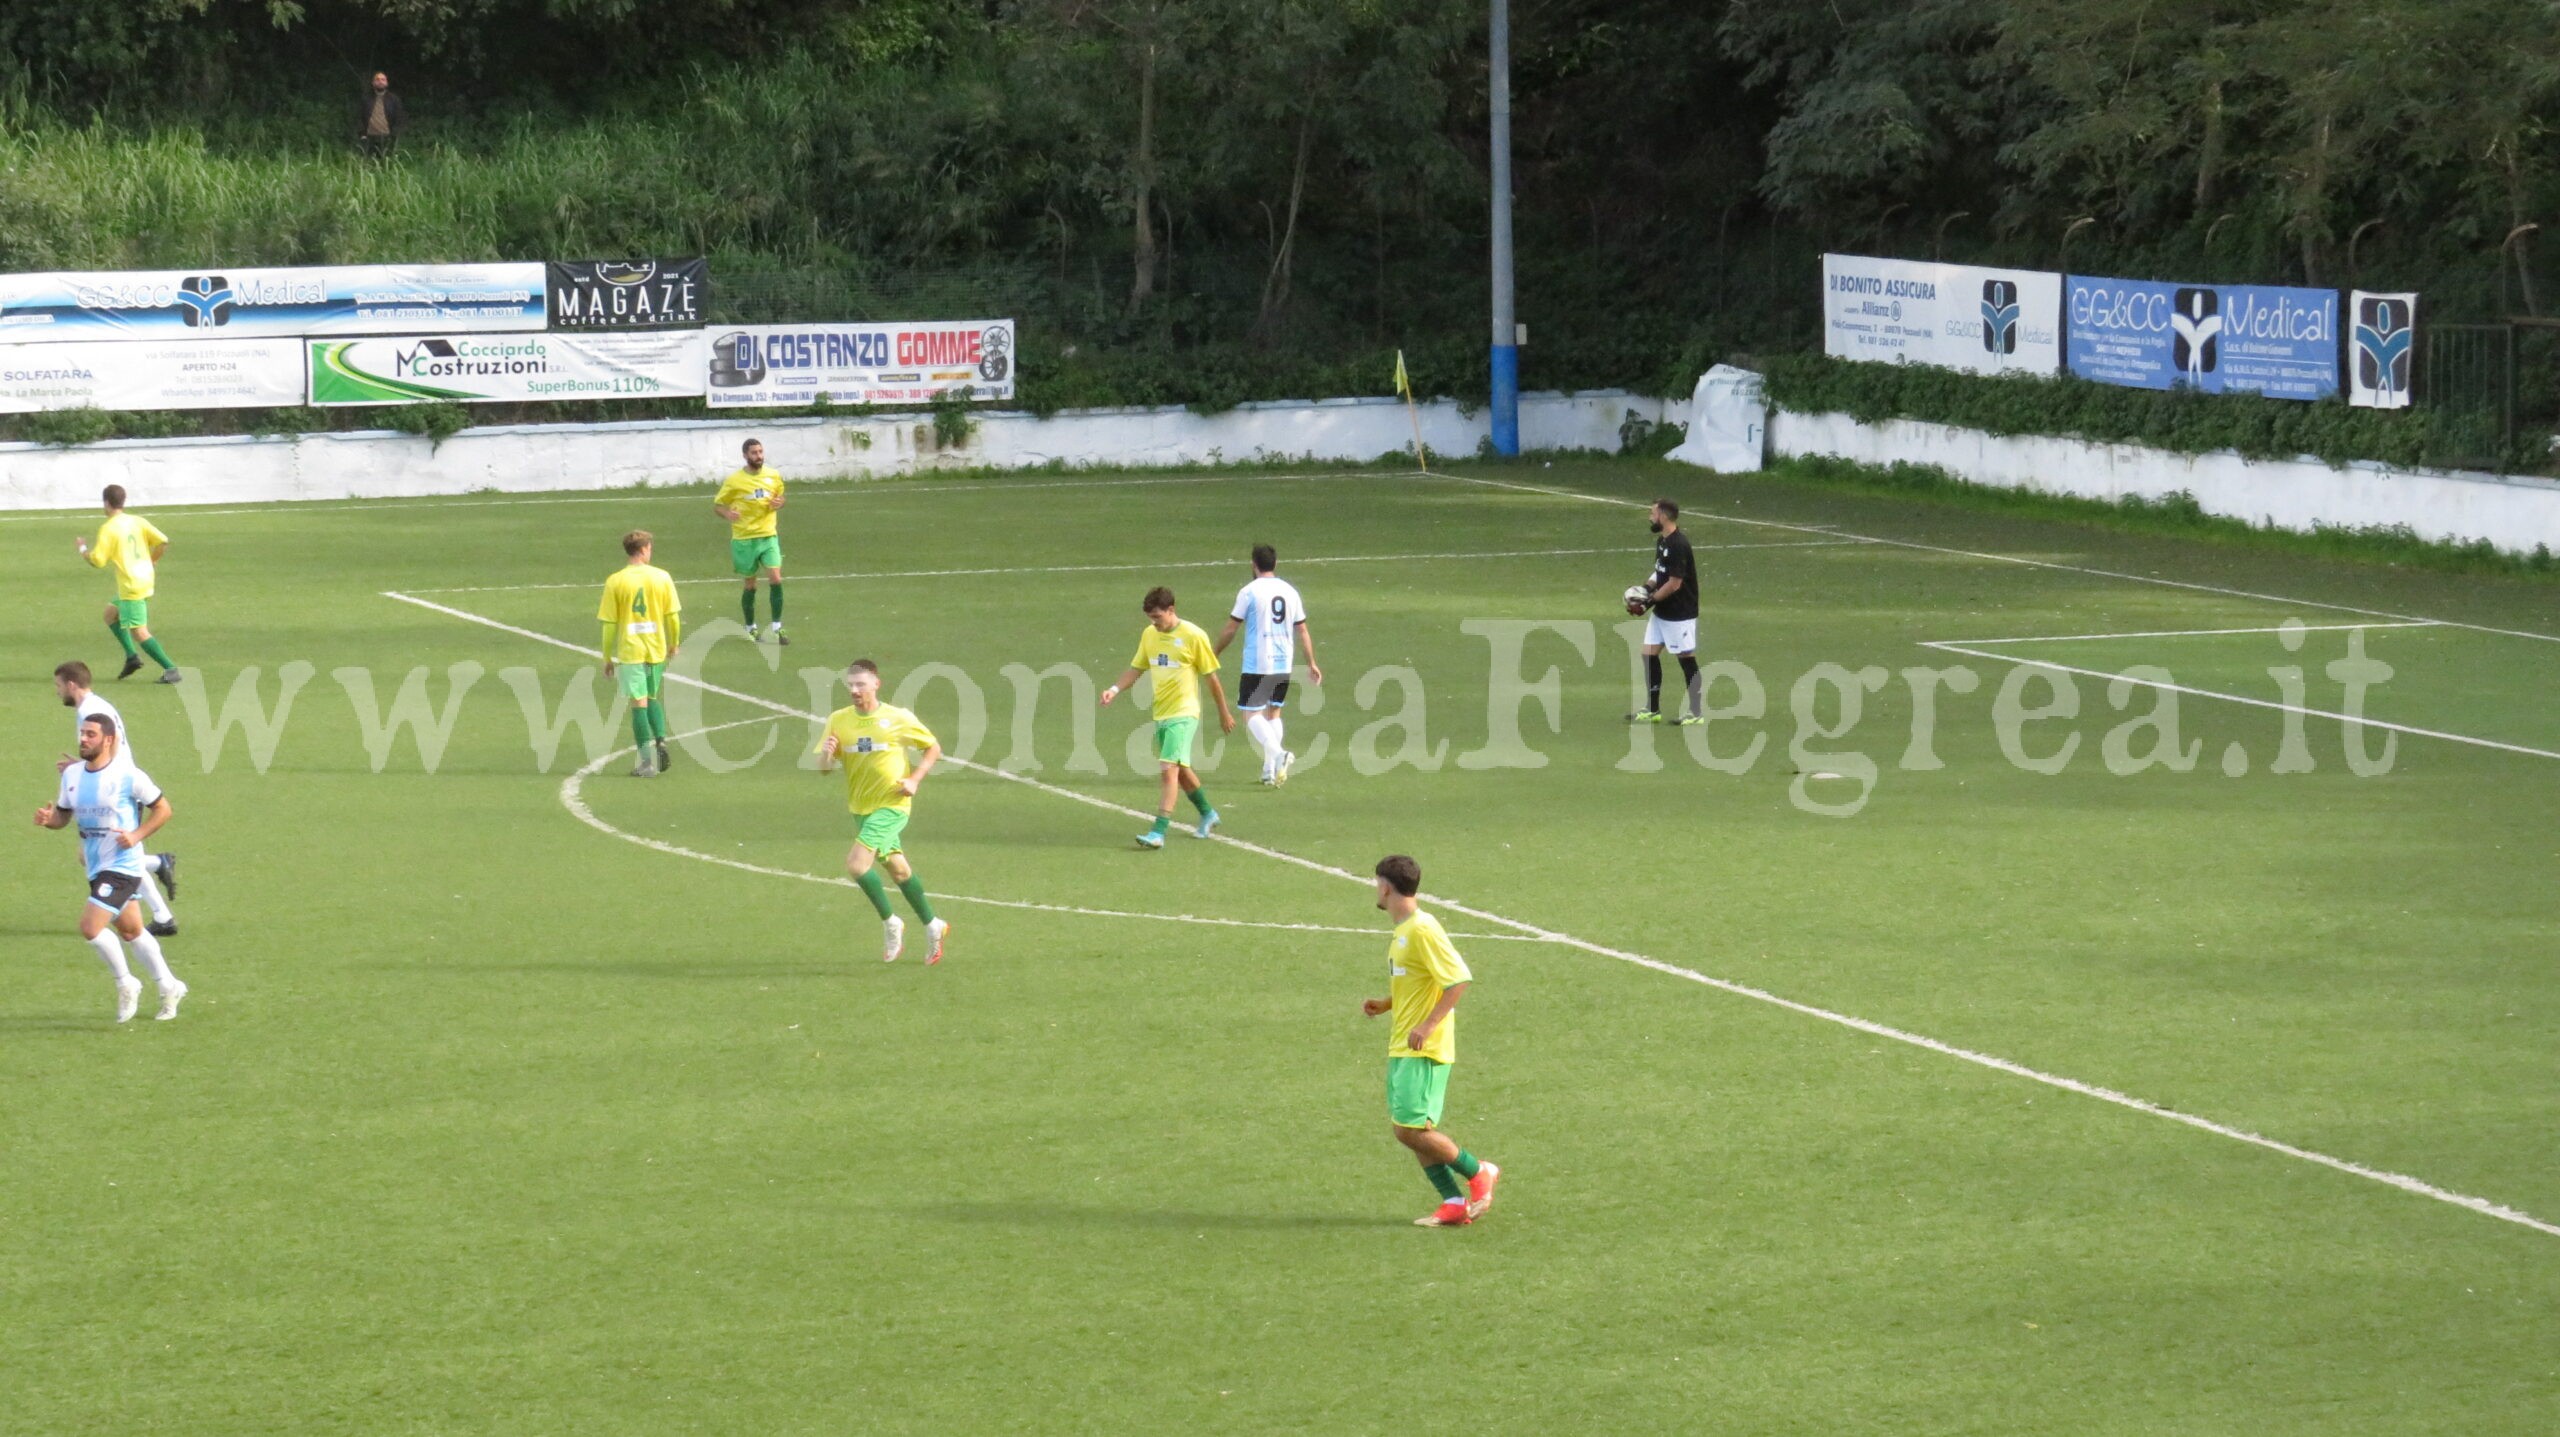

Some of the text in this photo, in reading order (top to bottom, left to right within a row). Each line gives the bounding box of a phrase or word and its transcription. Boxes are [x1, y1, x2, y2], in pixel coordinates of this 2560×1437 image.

[77, 279, 327, 307] GG&CC Medical
[559, 276, 696, 316] MAGAZÈ
[1840, 276, 1882, 295] BONITO
[1885, 281, 1936, 300] ASSICURA
[560, 312, 696, 325] coffee & drink
[1862, 301, 1890, 317] Allianz
[2072, 287, 2331, 341] GG&CC Medical
[2018, 326, 2053, 345] Medical
[458, 341, 546, 357] Cocciardo
[735, 330, 983, 370] DI COSTANZO GOMME
[4, 369, 93, 381] SOLFATARA
[182, 362, 237, 371] APERTO H24
[527, 376, 660, 394] SuperBonus 110%
[632, 587, 646, 617] 4
[1271, 595, 1286, 624] 9
